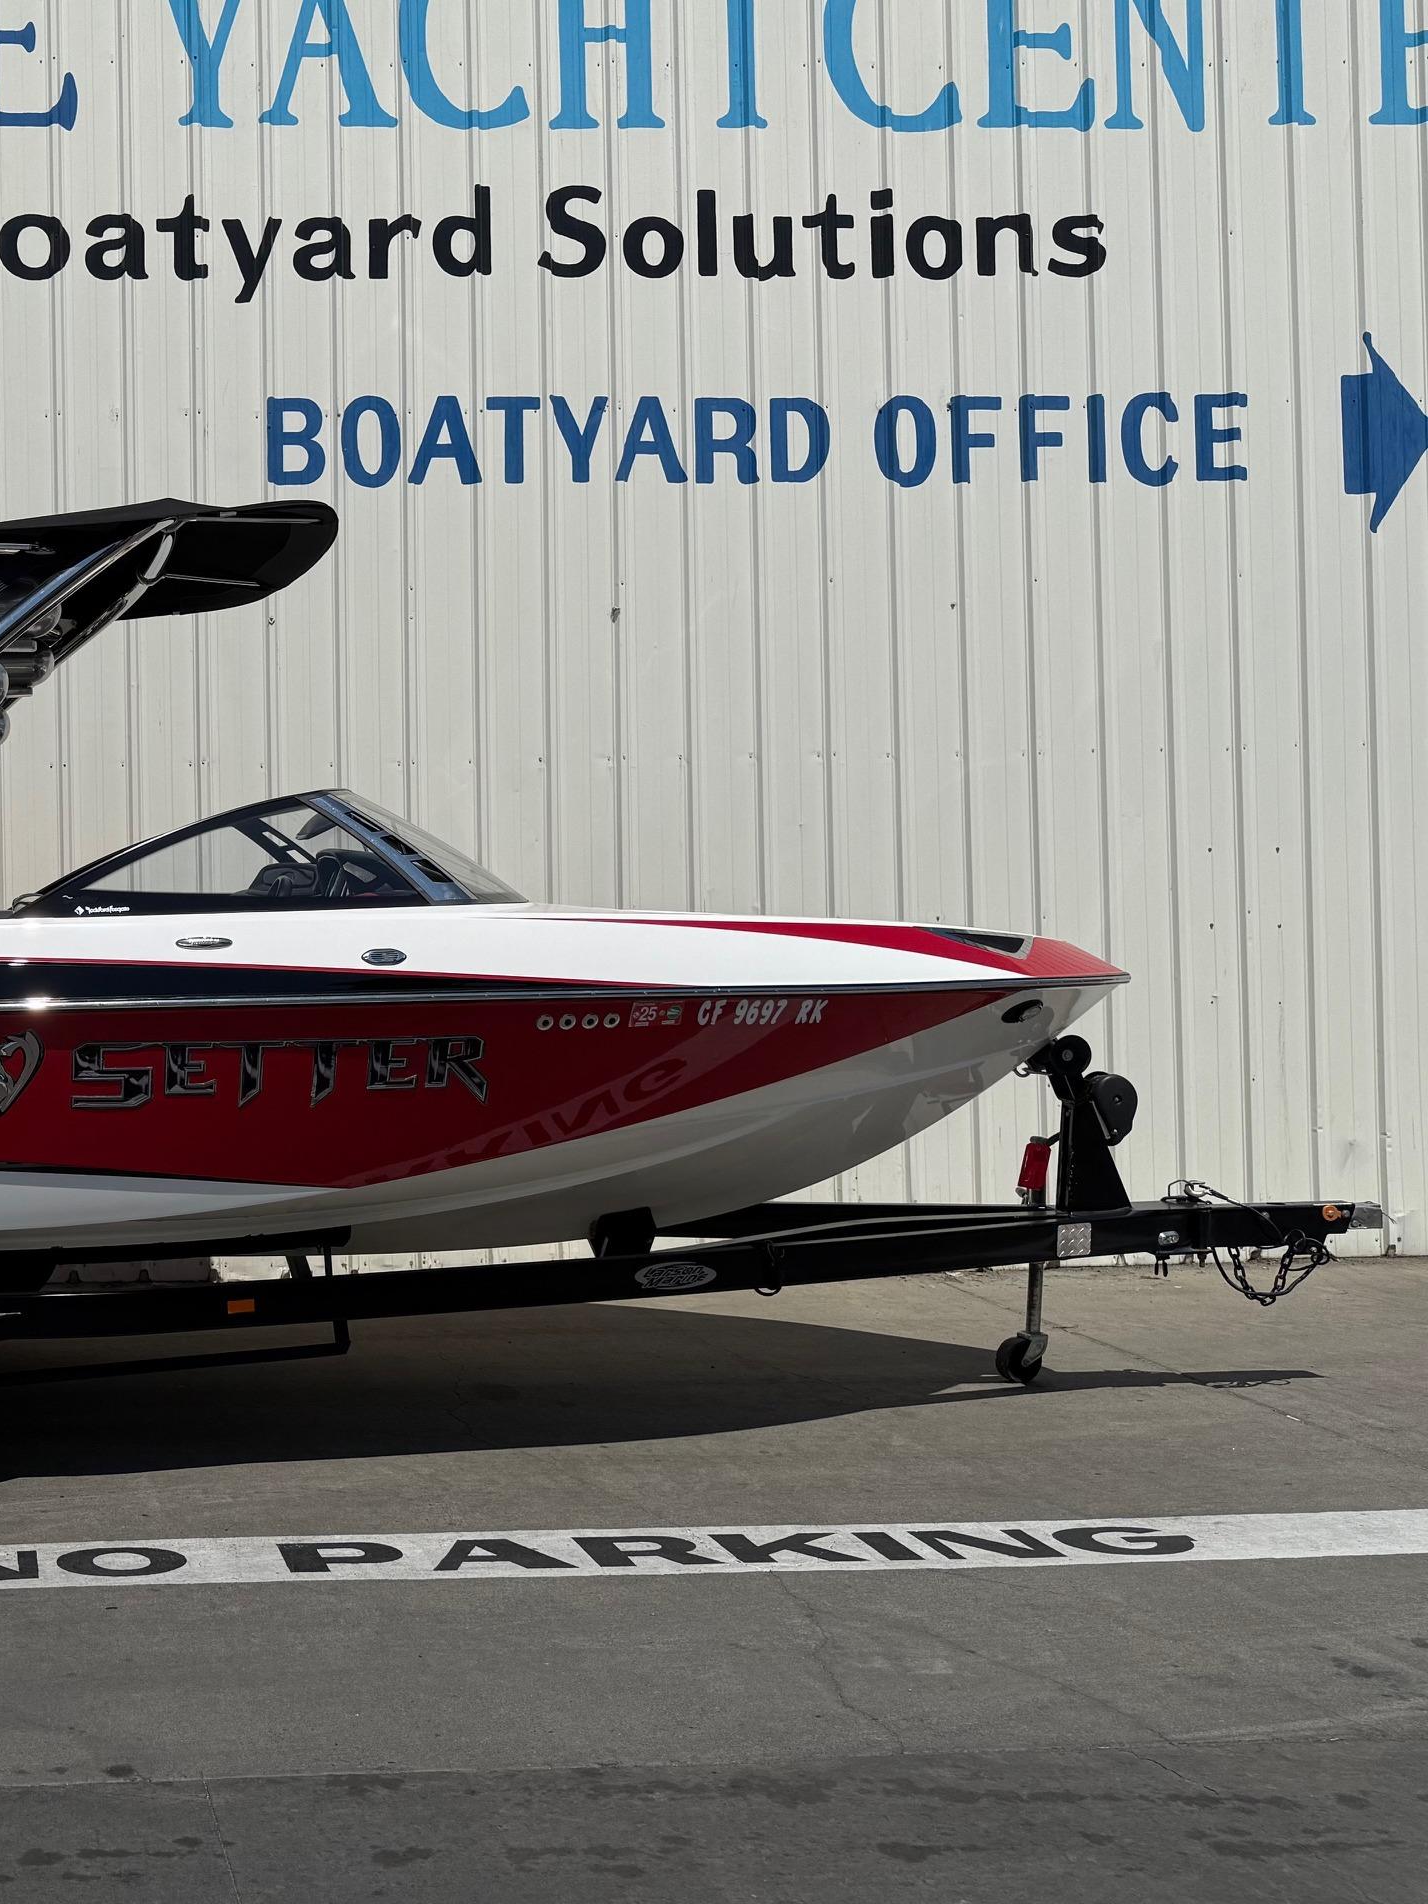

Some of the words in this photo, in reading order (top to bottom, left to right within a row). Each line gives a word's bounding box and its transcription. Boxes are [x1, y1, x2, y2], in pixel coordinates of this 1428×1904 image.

[537, 185, 1107, 281] Solutions
[266, 395, 831, 488] BOATYARD
[873, 392, 1247, 487] OFFICE
[638, 1006, 658, 1021] 25
[697, 999, 728, 1025] CF
[733, 999, 788, 1025] 9697
[794, 999, 829, 1025] RK
[71, 1036, 488, 1107] SETTER
[277, 1526, 1196, 1573] PARKING
